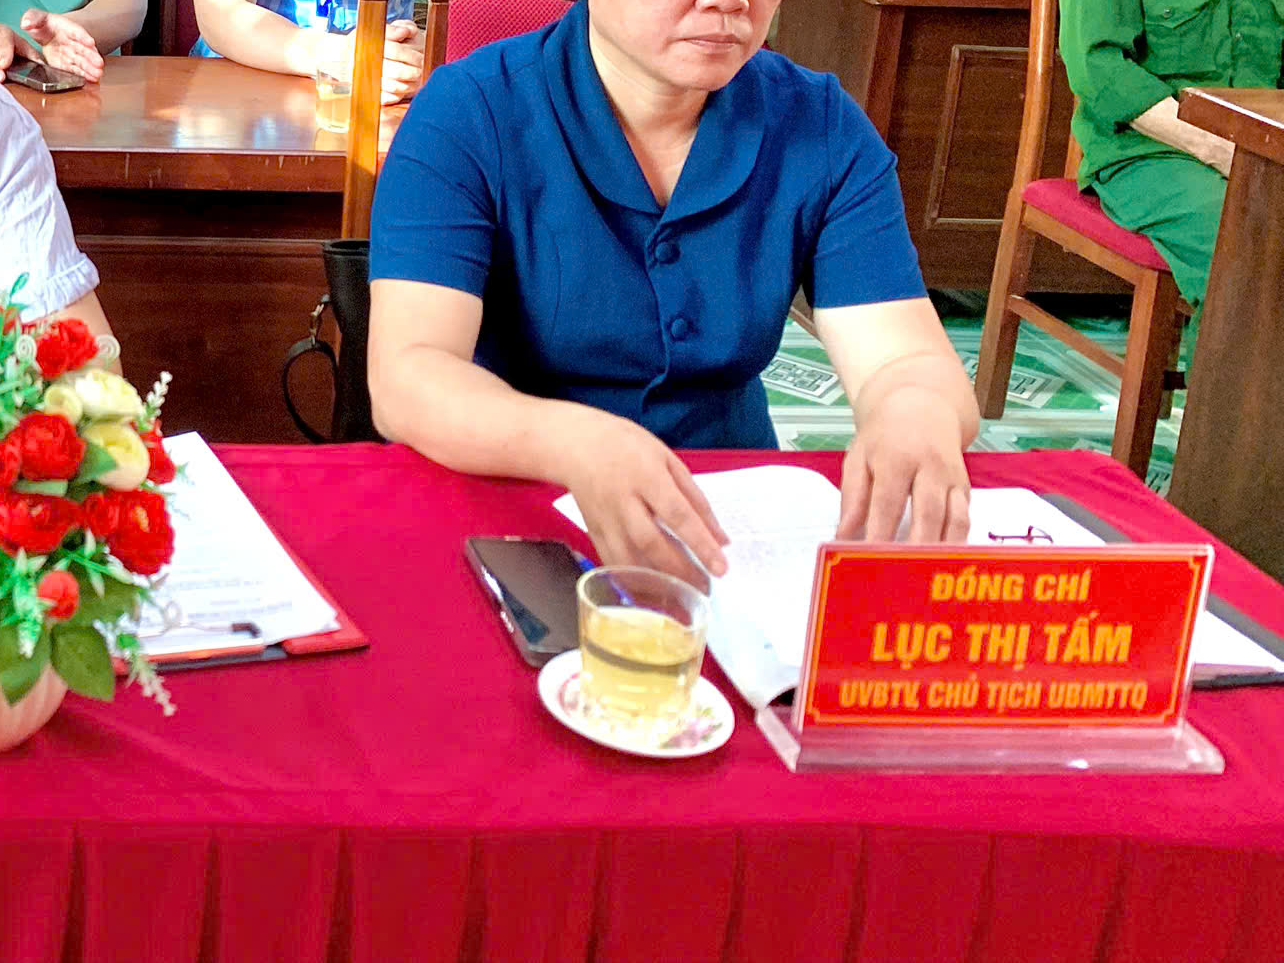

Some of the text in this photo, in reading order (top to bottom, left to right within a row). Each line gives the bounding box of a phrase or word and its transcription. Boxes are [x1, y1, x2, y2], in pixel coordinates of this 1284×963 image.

[1034, 568, 1092, 603] CHÍ
[872, 609, 1133, 672] LỤC THỊ TẤM
[928, 671, 980, 709] CHỦ
[987, 680, 1042, 714] TỊCH
[1048, 680, 1149, 711] UBMTTQ
